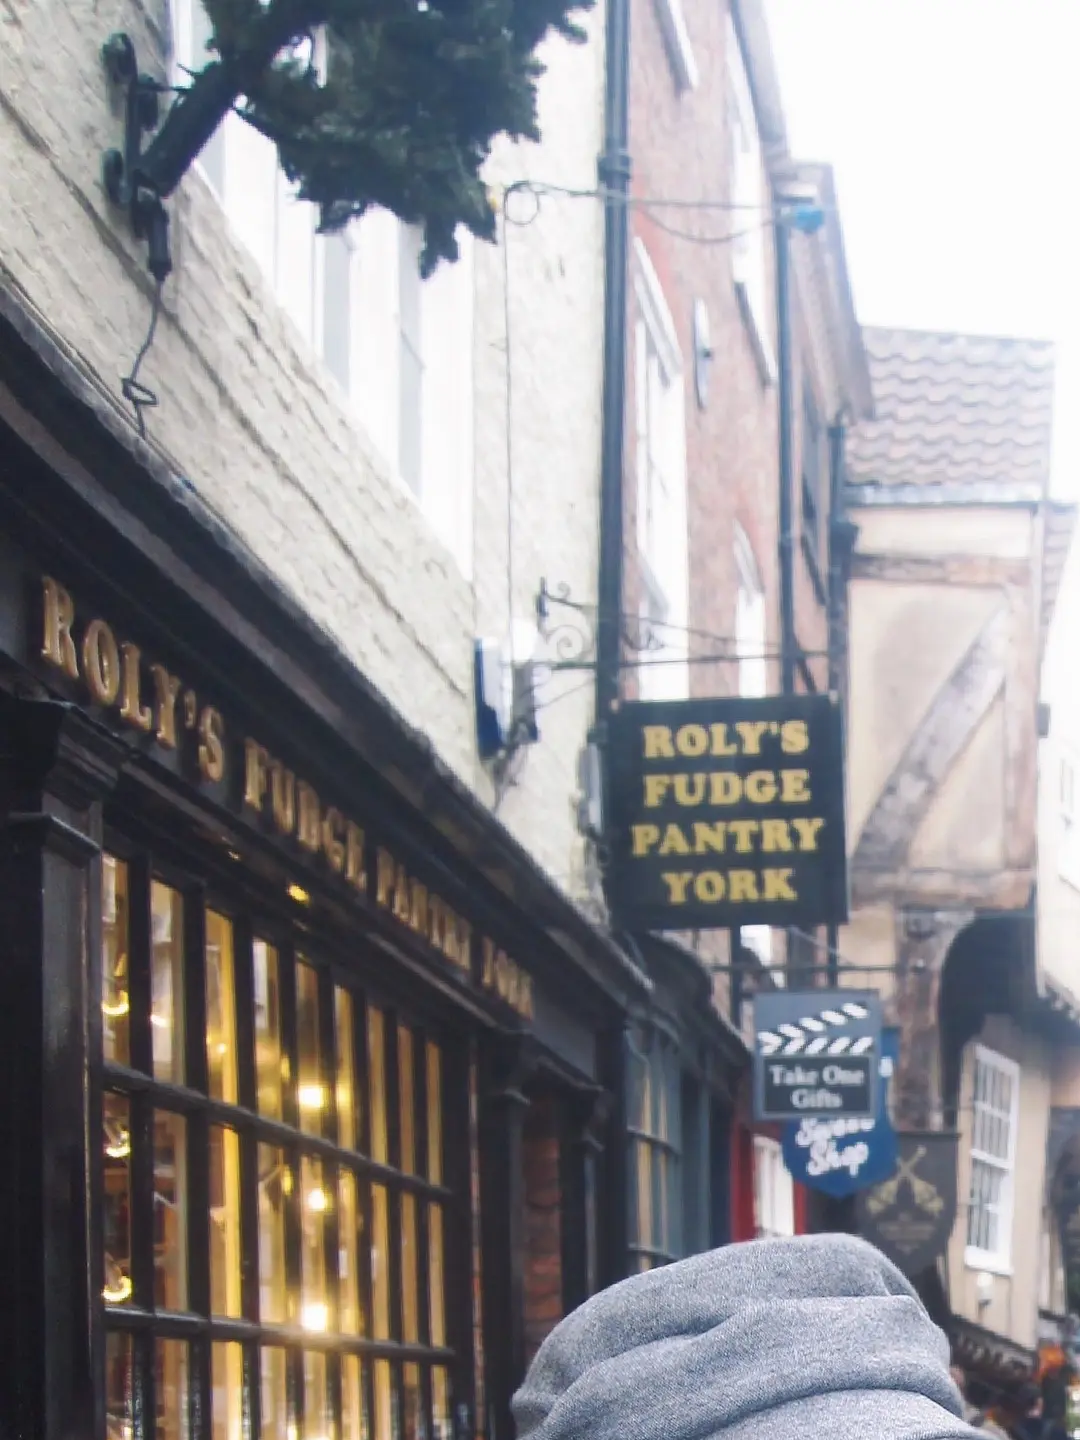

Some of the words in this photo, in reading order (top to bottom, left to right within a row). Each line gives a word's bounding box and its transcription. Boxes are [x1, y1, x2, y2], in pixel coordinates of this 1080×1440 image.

[41, 575, 224, 782] ROLY'S
[244, 737, 367, 892] FUDGE
[642, 720, 810, 758] ROLY'S
[643, 769, 812, 808] FUDGE
[631, 817, 825, 856] PANTRY
[661, 868, 798, 904] YORK
[769, 1064, 819, 1086] Take
